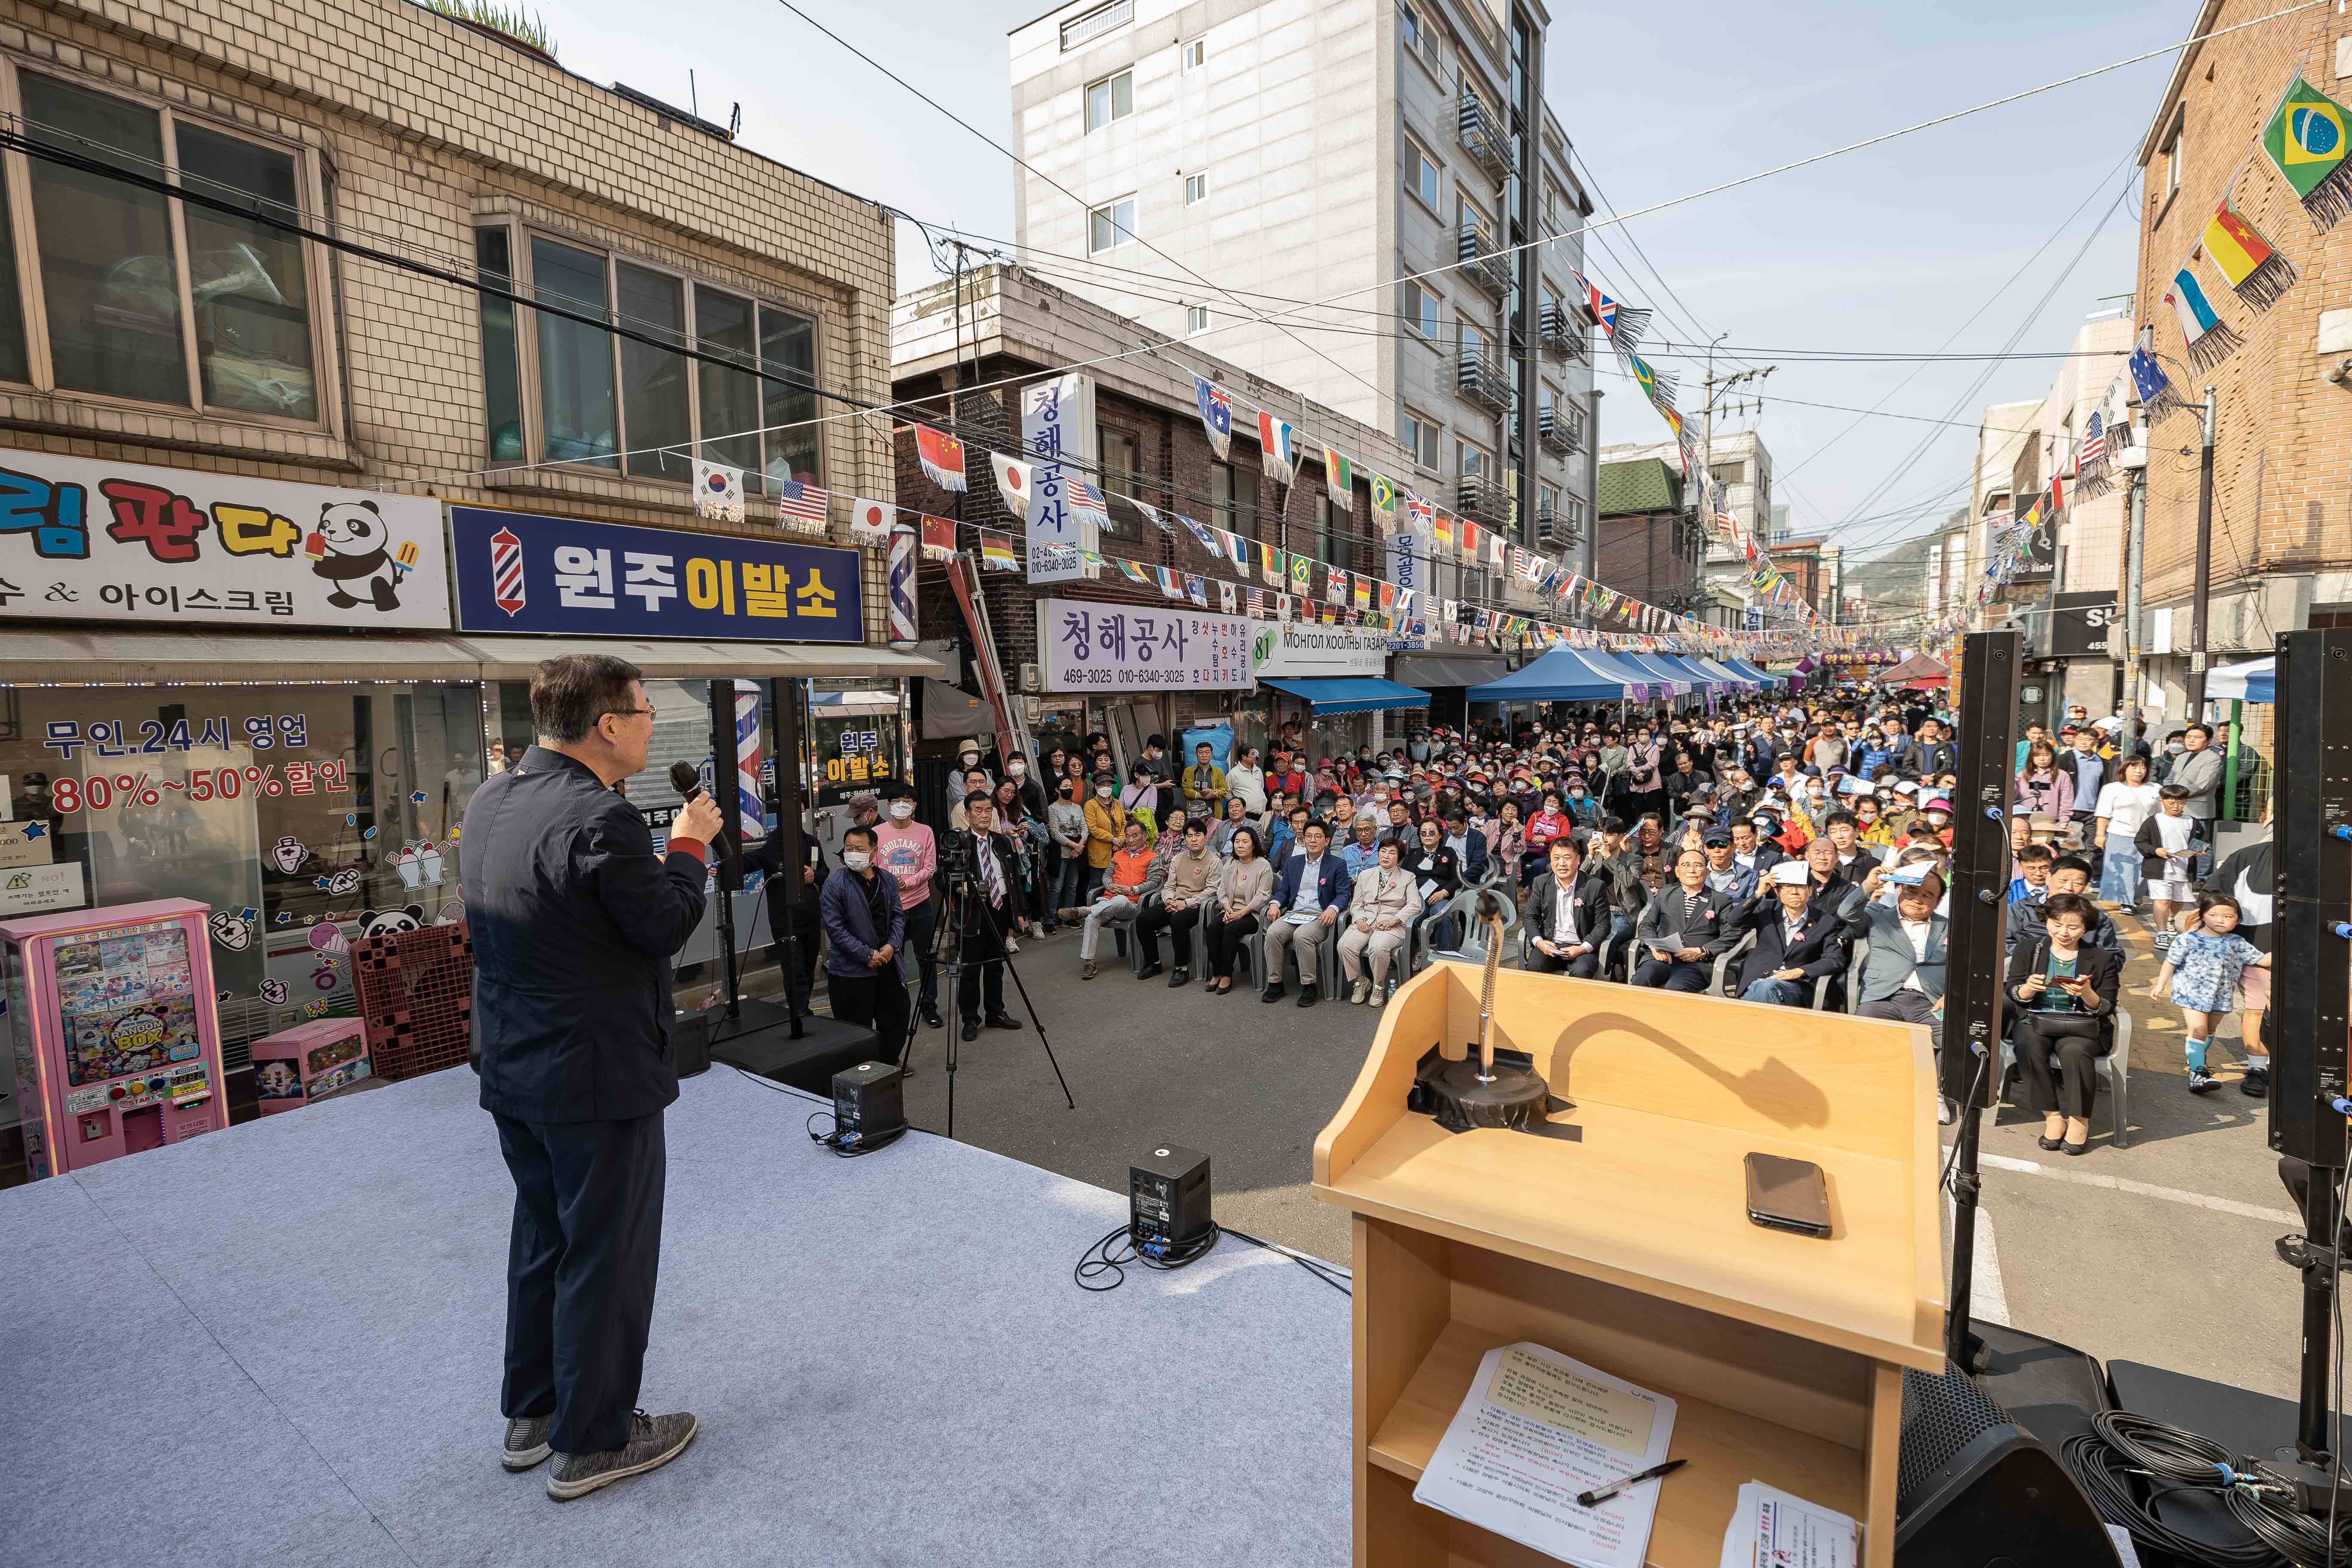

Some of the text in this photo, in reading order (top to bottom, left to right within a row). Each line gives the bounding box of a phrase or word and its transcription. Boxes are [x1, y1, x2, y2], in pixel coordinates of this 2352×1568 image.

[1033, 387, 1068, 534] 청해공사
[1032, 557, 1076, 573] 010-6340-3025
[45, 582, 79, 602] &
[99, 583, 294, 615] 아이스크림
[1062, 610, 1188, 663] 청해공사
[1283, 633, 1323, 649] МОНГОЛ
[1326, 635, 1362, 651] ХООЛНЫ
[1388, 640, 1424, 649] 2201-3850
[1255, 637, 1271, 660] 81
[1063, 669, 1184, 683] 469-3025 010-6340-3025
[243, 714, 308, 751] 영업
[840, 731, 878, 753] 원주
[827, 755, 889, 781] 이발소
[888, 865, 916, 874] VINTAGE
[111, 1020, 164, 1040] RANDOM
[117, 1029, 163, 1051] BOX
[129, 1095, 156, 1106] START
[1536, 1388, 1554, 1399] 주시고
[1538, 1382, 1549, 1390] 다소
[1529, 1399, 1541, 1407] 모든
[1568, 1407, 1586, 1418] 시간이
